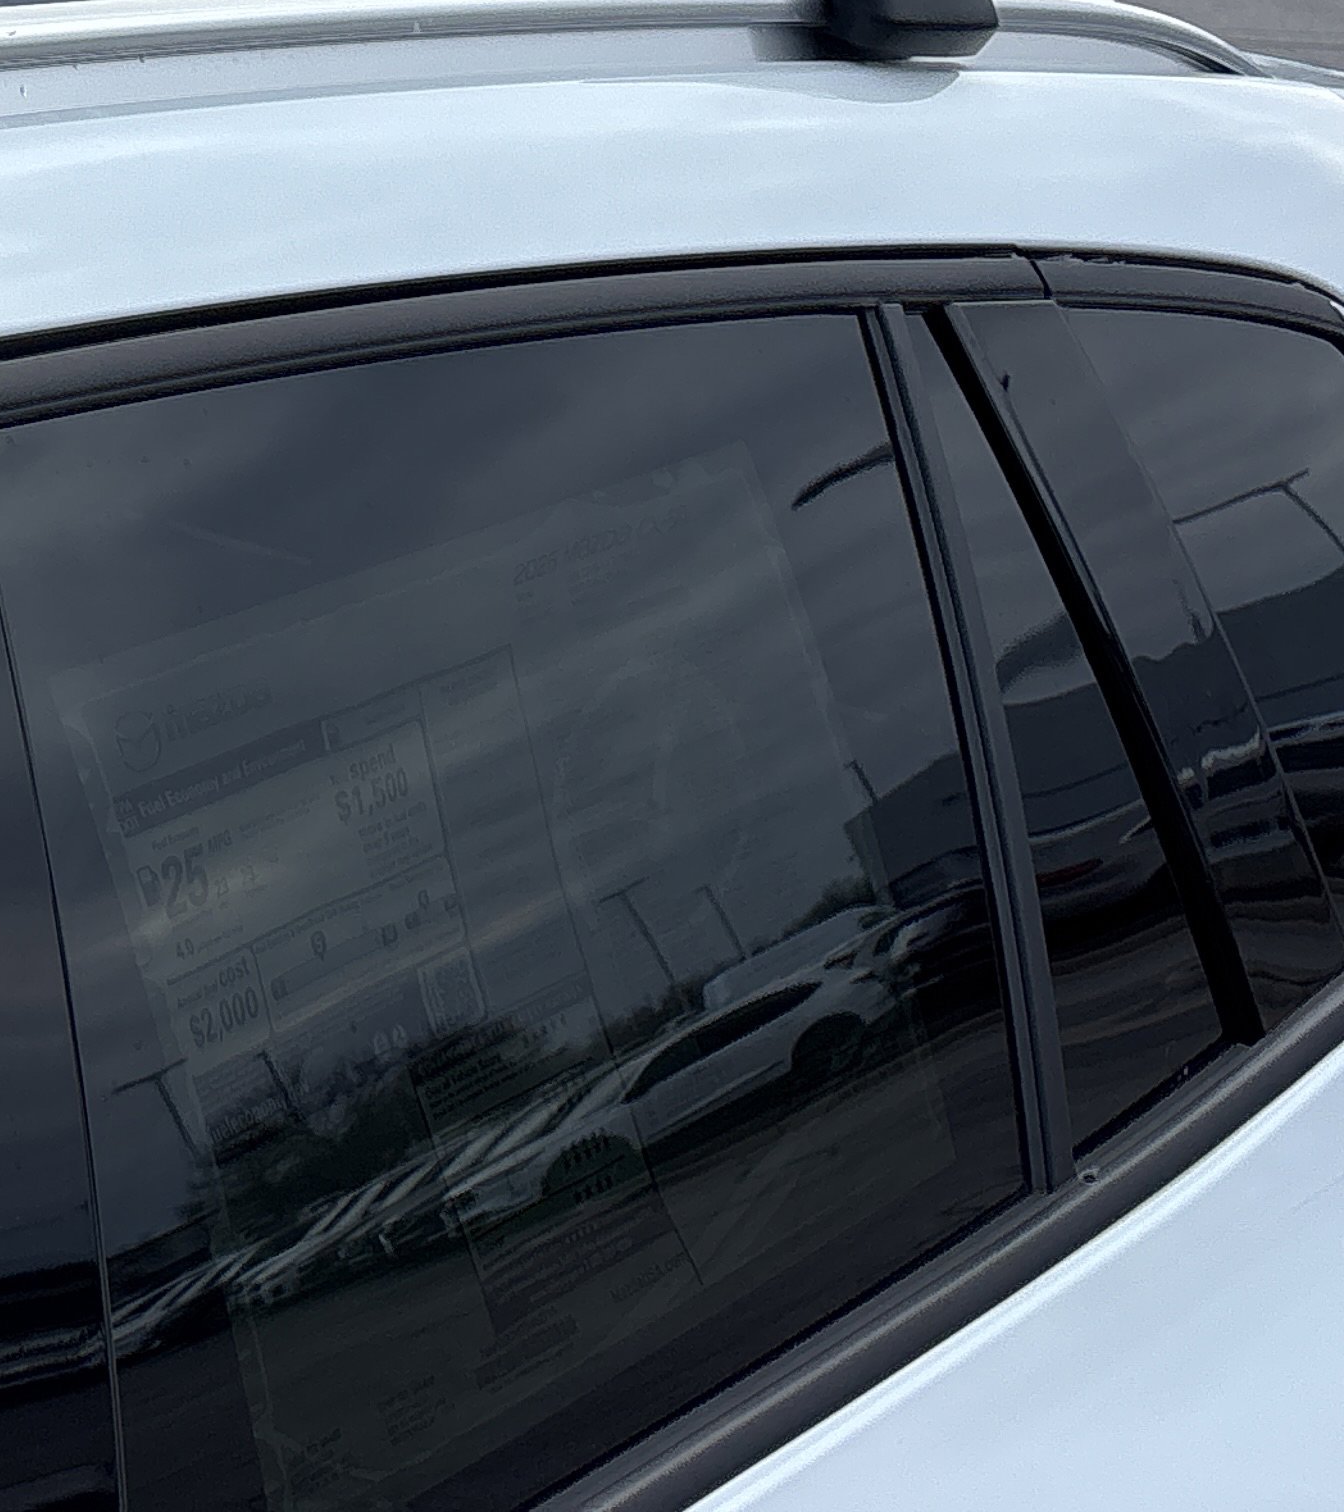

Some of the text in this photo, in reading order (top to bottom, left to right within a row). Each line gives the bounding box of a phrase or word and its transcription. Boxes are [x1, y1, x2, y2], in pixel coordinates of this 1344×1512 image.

[349, 742, 397, 781] spend
[138, 795, 168, 818] Fuel
[334, 766, 409, 827] $1,500
[161, 842, 210, 920] 25
[218, 955, 251, 987] cost
[188, 986, 260, 1049] $2,000
